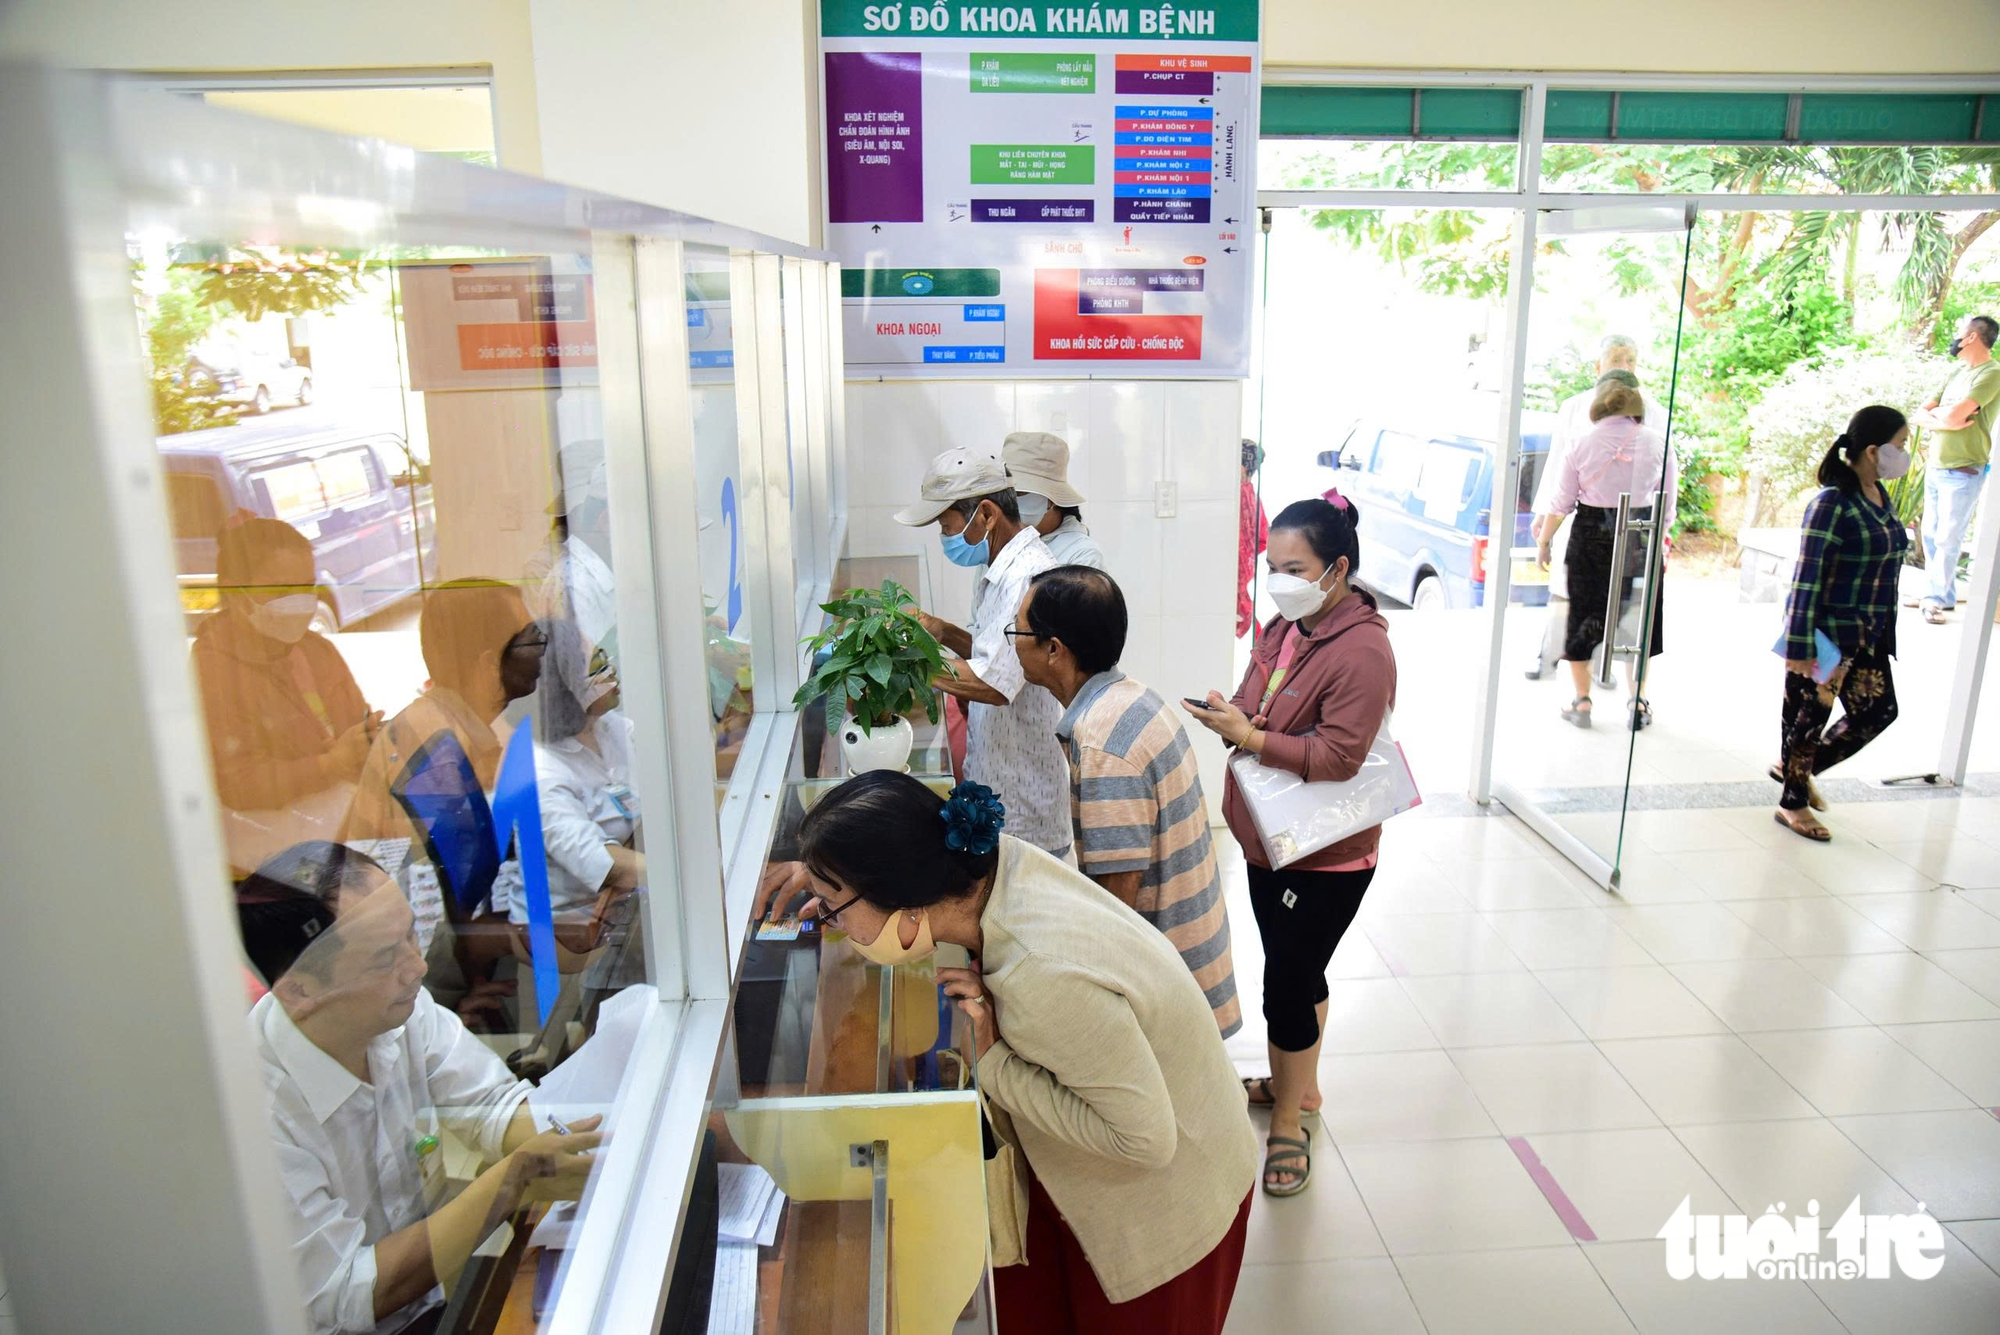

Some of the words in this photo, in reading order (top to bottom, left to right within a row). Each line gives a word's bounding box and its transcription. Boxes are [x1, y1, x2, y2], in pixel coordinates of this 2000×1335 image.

[863, 3, 901, 31] SƠ
[909, 0, 949, 31] ĐỒ
[960, 7, 1037, 32] KHOA
[1047, 2, 1129, 33] KHÁM
[1139, 3, 1214, 39] BỆNH
[1160, 59, 1175, 67] KHU
[1178, 58, 1187, 68] VỆ
[1190, 59, 1208, 68] SINH
[1144, 73, 1173, 81] P.CHỤP
[844, 113, 862, 122] KHOA
[863, 111, 876, 122] XÉT
[878, 110, 904, 123] NGHIỆM
[1161, 108, 1188, 117] PHÒNG
[839, 123, 857, 136] CHẨN
[859, 125, 876, 136] ĐOÁN
[878, 124, 894, 136] HÌNH
[896, 124, 910, 136] ẢNH
[1132, 122, 1162, 130] P.KHÁM
[1166, 122, 1187, 130] ĐÔNG
[1226, 126, 1234, 150] LANG
[844, 139, 862, 152] (SIÊU
[864, 140, 877, 151] ÂM,
[879, 139, 890, 151] NỘI
[892, 141, 905, 151] SOI,
[1012, 150, 1025, 158] LIÊN
[1027, 150, 1049, 158] CHUYÊN
[859, 155, 891, 165] X-QUANG)
[1000, 159, 1012, 168] MẮT
[1049, 161, 1065, 169] HỌNG
[1169, 161, 1182, 169] NỘI
[1224, 153, 1233, 177] HÀNH
[1010, 170, 1026, 178] RĂNG
[1028, 170, 1041, 178] HÀM
[1043, 170, 1055, 179] MẶT
[1169, 174, 1183, 182] NỘI
[1134, 200, 1163, 208] P.HÀNH
[1165, 200, 1191, 208] CHÁNH
[988, 208, 999, 217] THU
[1000, 206, 1016, 217] NGÂN
[1041, 205, 1050, 217] CẤP
[1050, 206, 1061, 217] PHÁT
[1061, 205, 1074, 217] THUỐC
[1153, 211, 1171, 220] TIẾP
[1173, 213, 1194, 221] NHẬN
[1087, 276, 1104, 285] PHÒNG
[1149, 275, 1158, 284] NHÀ
[1159, 274, 1174, 285] THUỐC
[1175, 275, 1187, 285] BỆNH
[1188, 275, 1199, 285] VIỆN
[1093, 297, 1112, 307] PHÒNG
[1114, 299, 1129, 307] KHTH
[876, 323, 905, 335] KHOA
[909, 323, 941, 337] NGOẠI
[1050, 338, 1070, 349] KHOA
[1087, 335, 1102, 349] SỨC
[1104, 334, 1119, 349] CẤP
[1120, 336, 1136, 349] CỨU
[1142, 335, 1167, 349] CHỐNG
[1168, 336, 1184, 352] ĐỘC
[721, 477, 742, 637] 2
[492, 714, 561, 1029] 1
